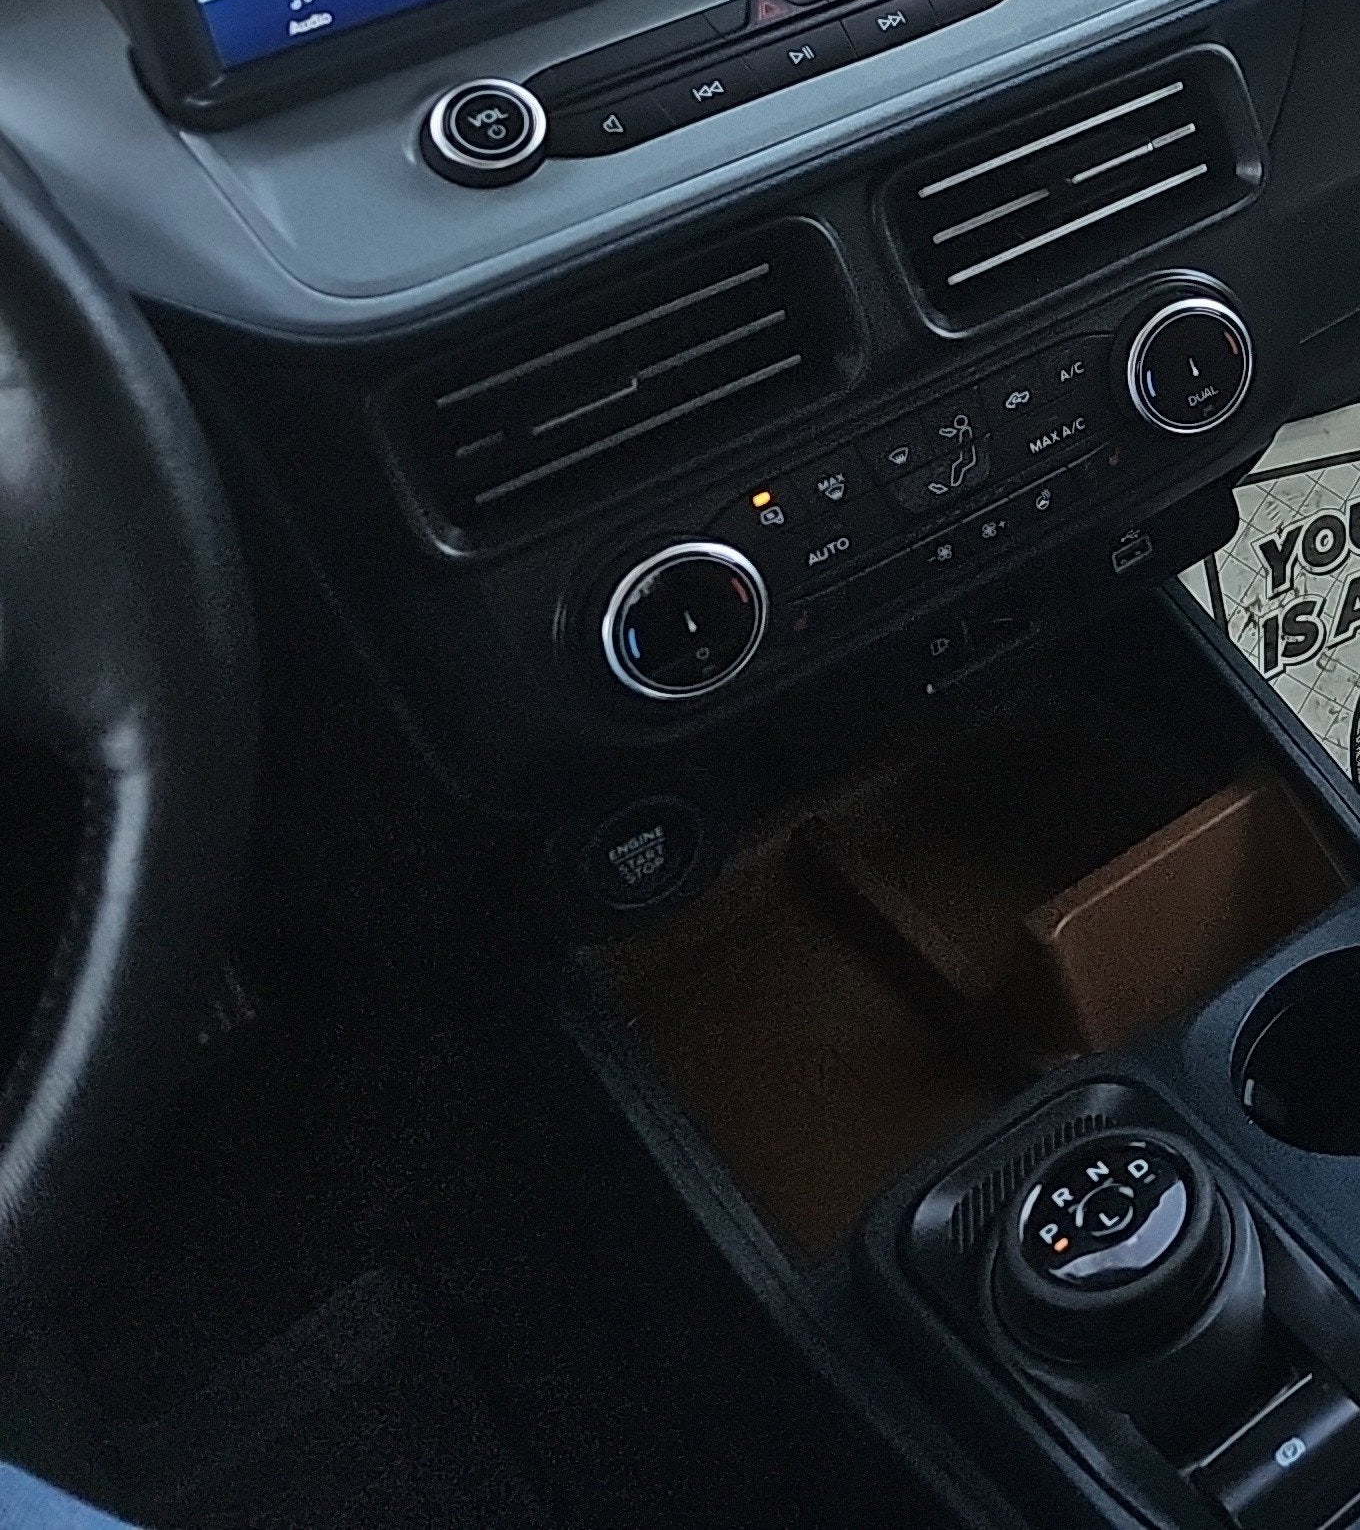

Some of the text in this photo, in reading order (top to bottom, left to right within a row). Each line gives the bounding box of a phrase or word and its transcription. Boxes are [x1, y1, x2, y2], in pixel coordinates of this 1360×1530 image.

[288, 10, 334, 37] Audio
[467, 104, 508, 129] VOL
[1060, 361, 1085, 382] A/C
[1186, 385, 1220, 407] DUAL
[1029, 417, 1086, 454] MAX A/C
[817, 473, 846, 492] MAX
[808, 537, 850, 567] AUTO
[1261, 600, 1328, 674] IS
[608, 825, 665, 864] ENGINE
[1086, 1160, 1110, 1182] N
[1127, 1158, 1149, 1179] D
[1051, 1187, 1074, 1207] R
[1098, 1212, 1120, 1227] L
[1038, 1223, 1060, 1246] P
